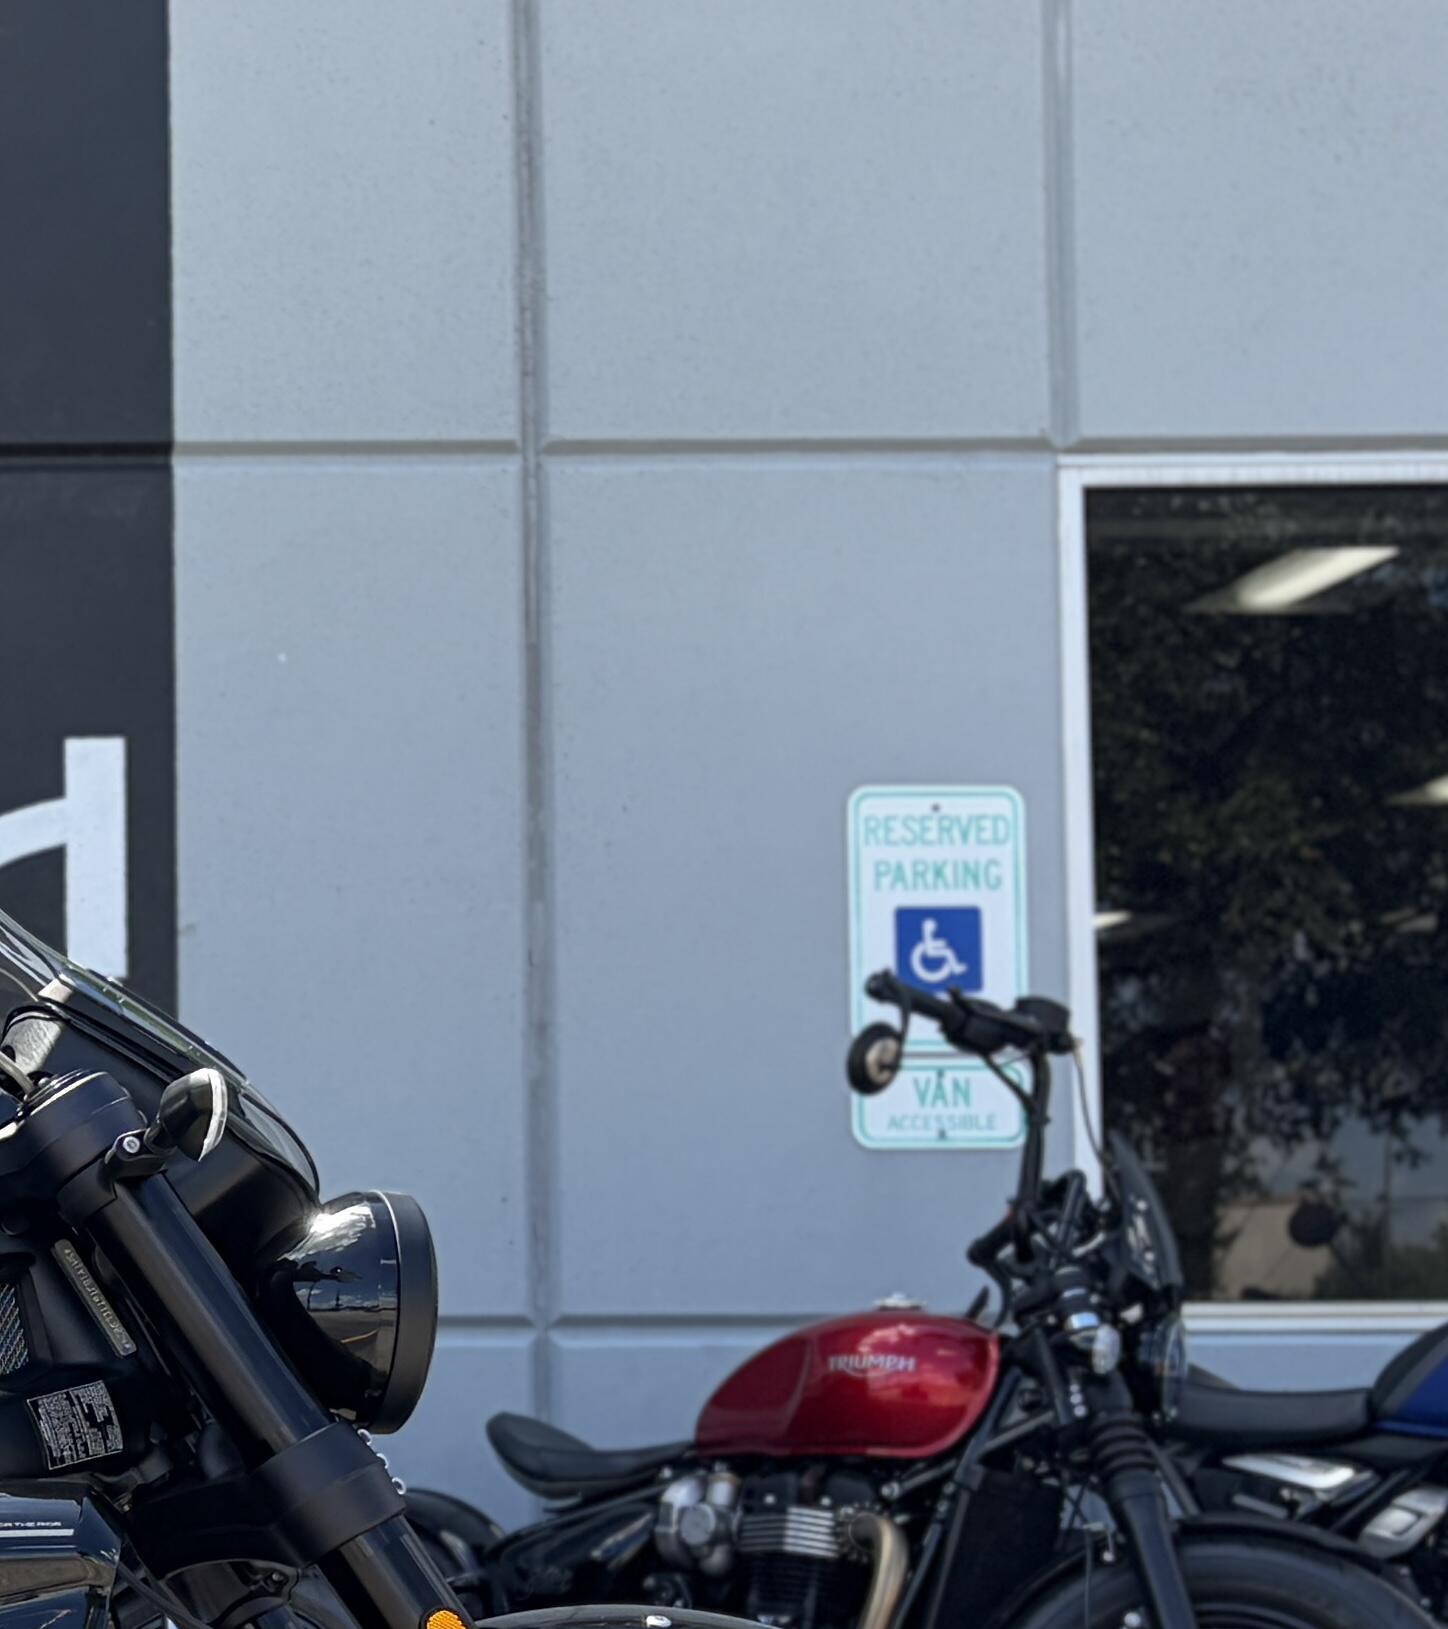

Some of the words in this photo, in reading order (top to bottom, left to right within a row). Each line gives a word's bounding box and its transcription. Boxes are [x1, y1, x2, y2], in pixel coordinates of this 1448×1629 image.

[863, 814, 1011, 847] RESERVED
[873, 859, 1003, 892] PARKING
[912, 1076, 972, 1108] VAN
[886, 1112, 997, 1131] ACCESSIBLE
[828, 1353, 916, 1377] TRIUMPH
